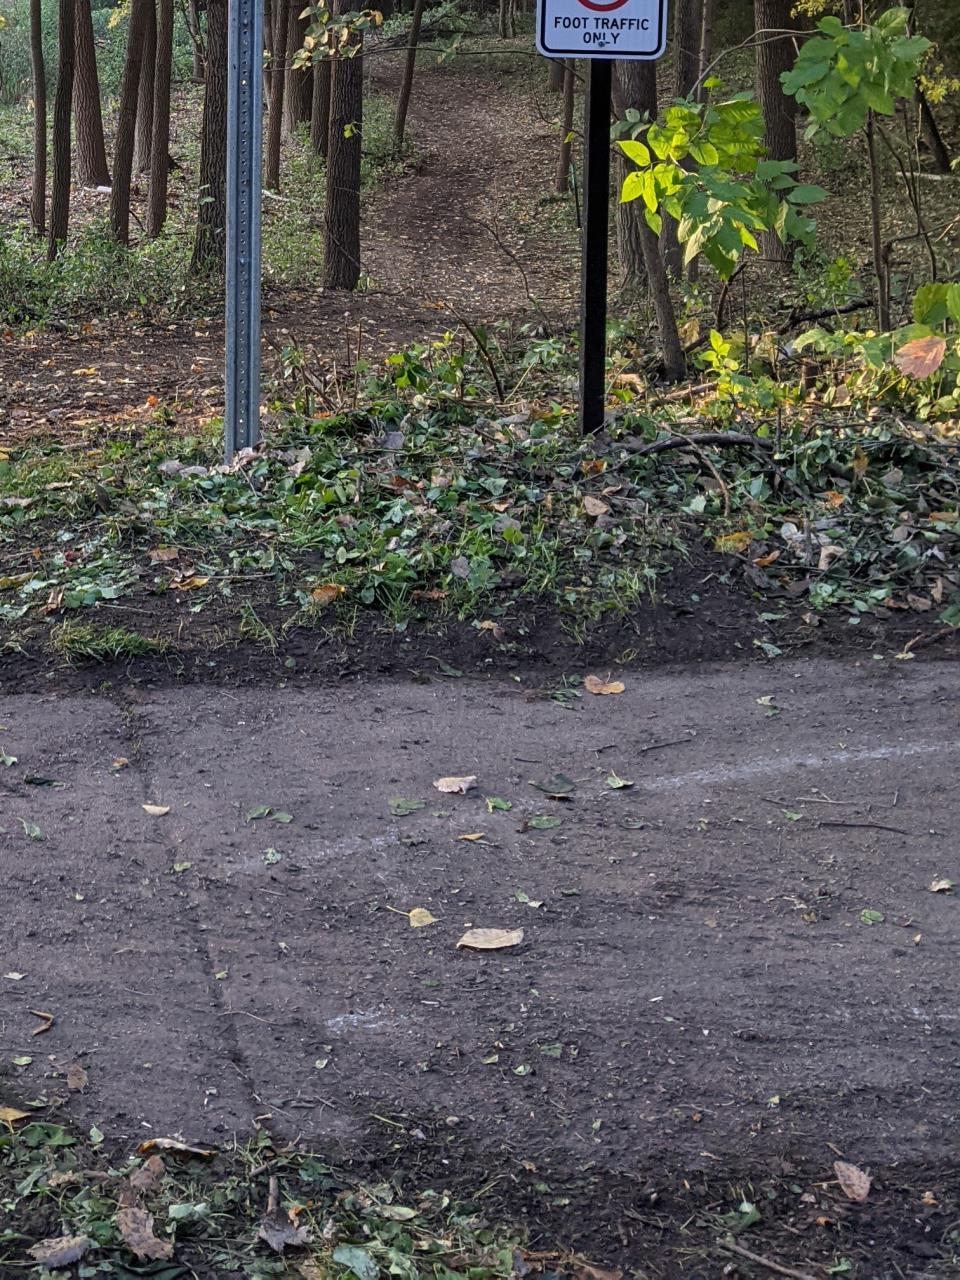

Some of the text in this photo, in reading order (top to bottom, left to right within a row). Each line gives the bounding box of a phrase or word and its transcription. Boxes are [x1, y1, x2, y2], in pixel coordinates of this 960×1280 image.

[554, 17, 649, 30] FOOT TRAFFIC
[583, 32, 620, 44] ONLY
